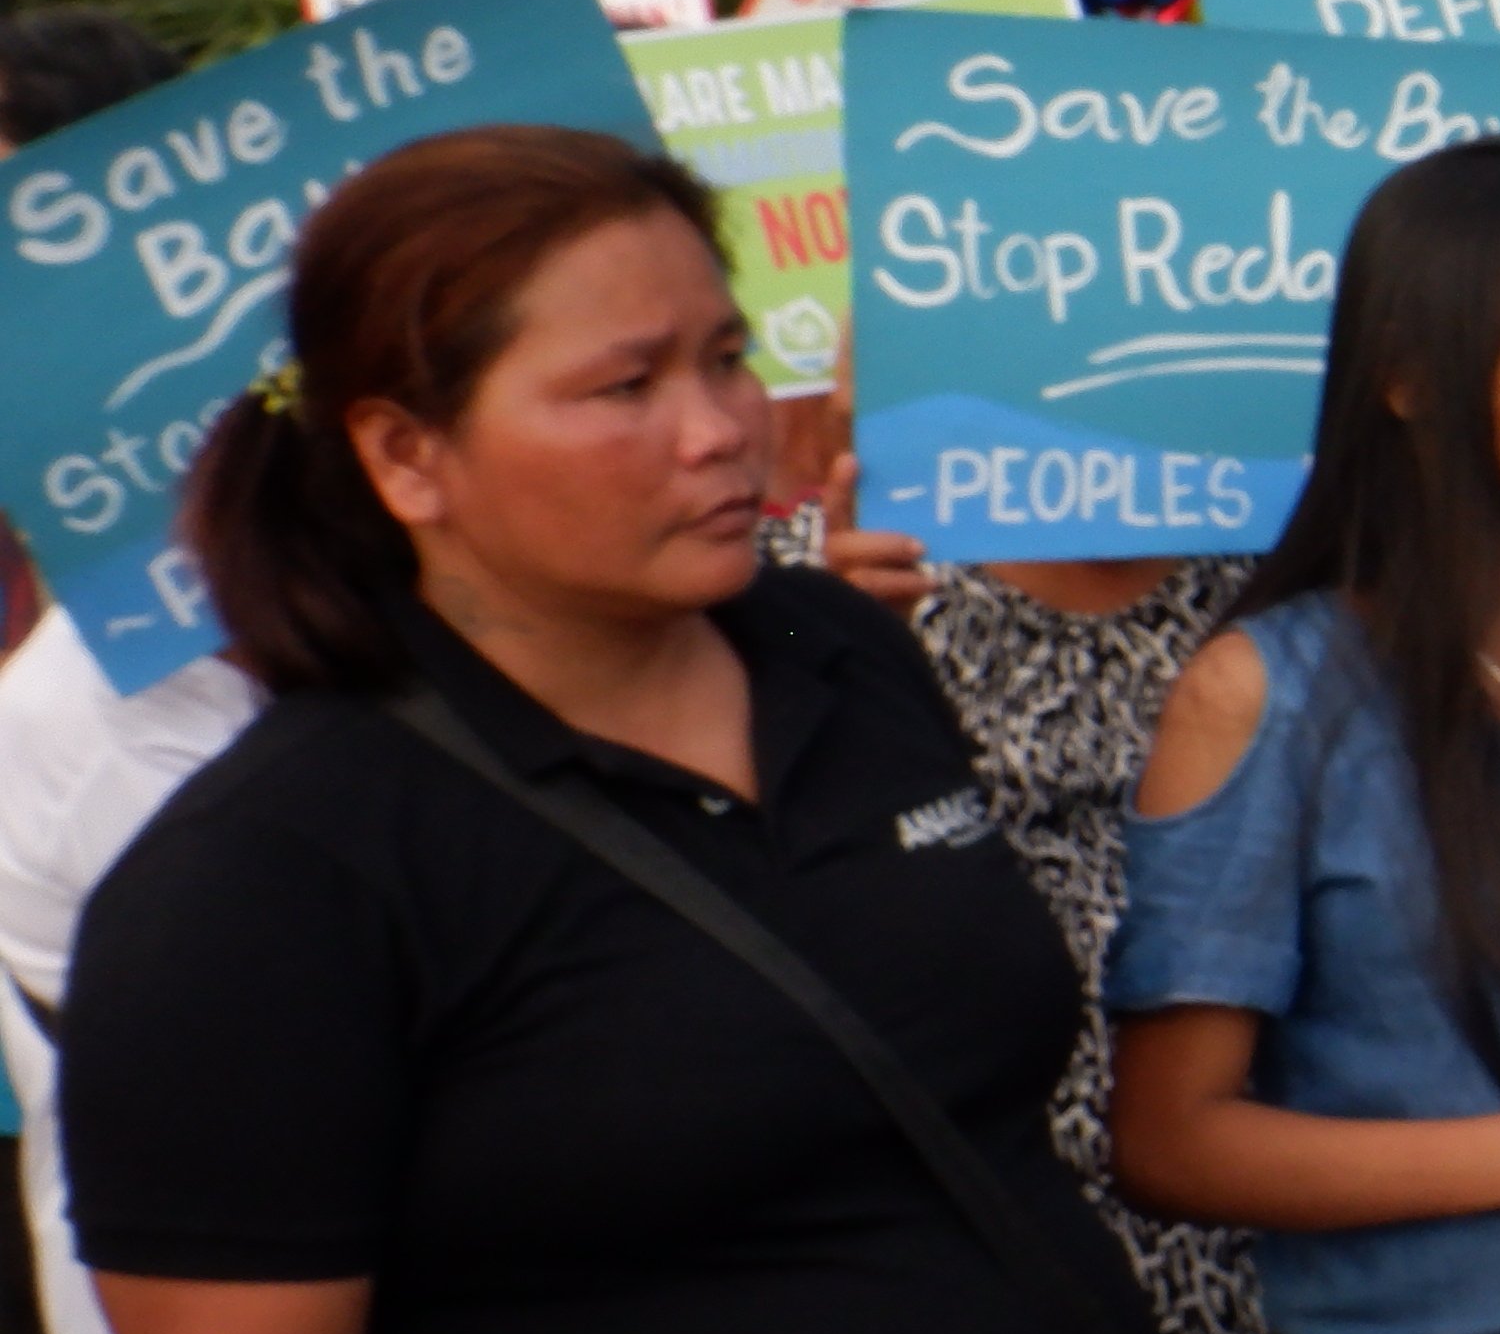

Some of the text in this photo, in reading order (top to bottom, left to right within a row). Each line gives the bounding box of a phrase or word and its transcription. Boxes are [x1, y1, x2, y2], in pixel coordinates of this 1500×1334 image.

[7, 20, 477, 268] Save the
[893, 52, 1228, 160] Save
[1256, 58, 1366, 150] the
[133, 179, 333, 323] Ba
[757, 187, 850, 269] NO
[873, 189, 1099, 325] Stop
